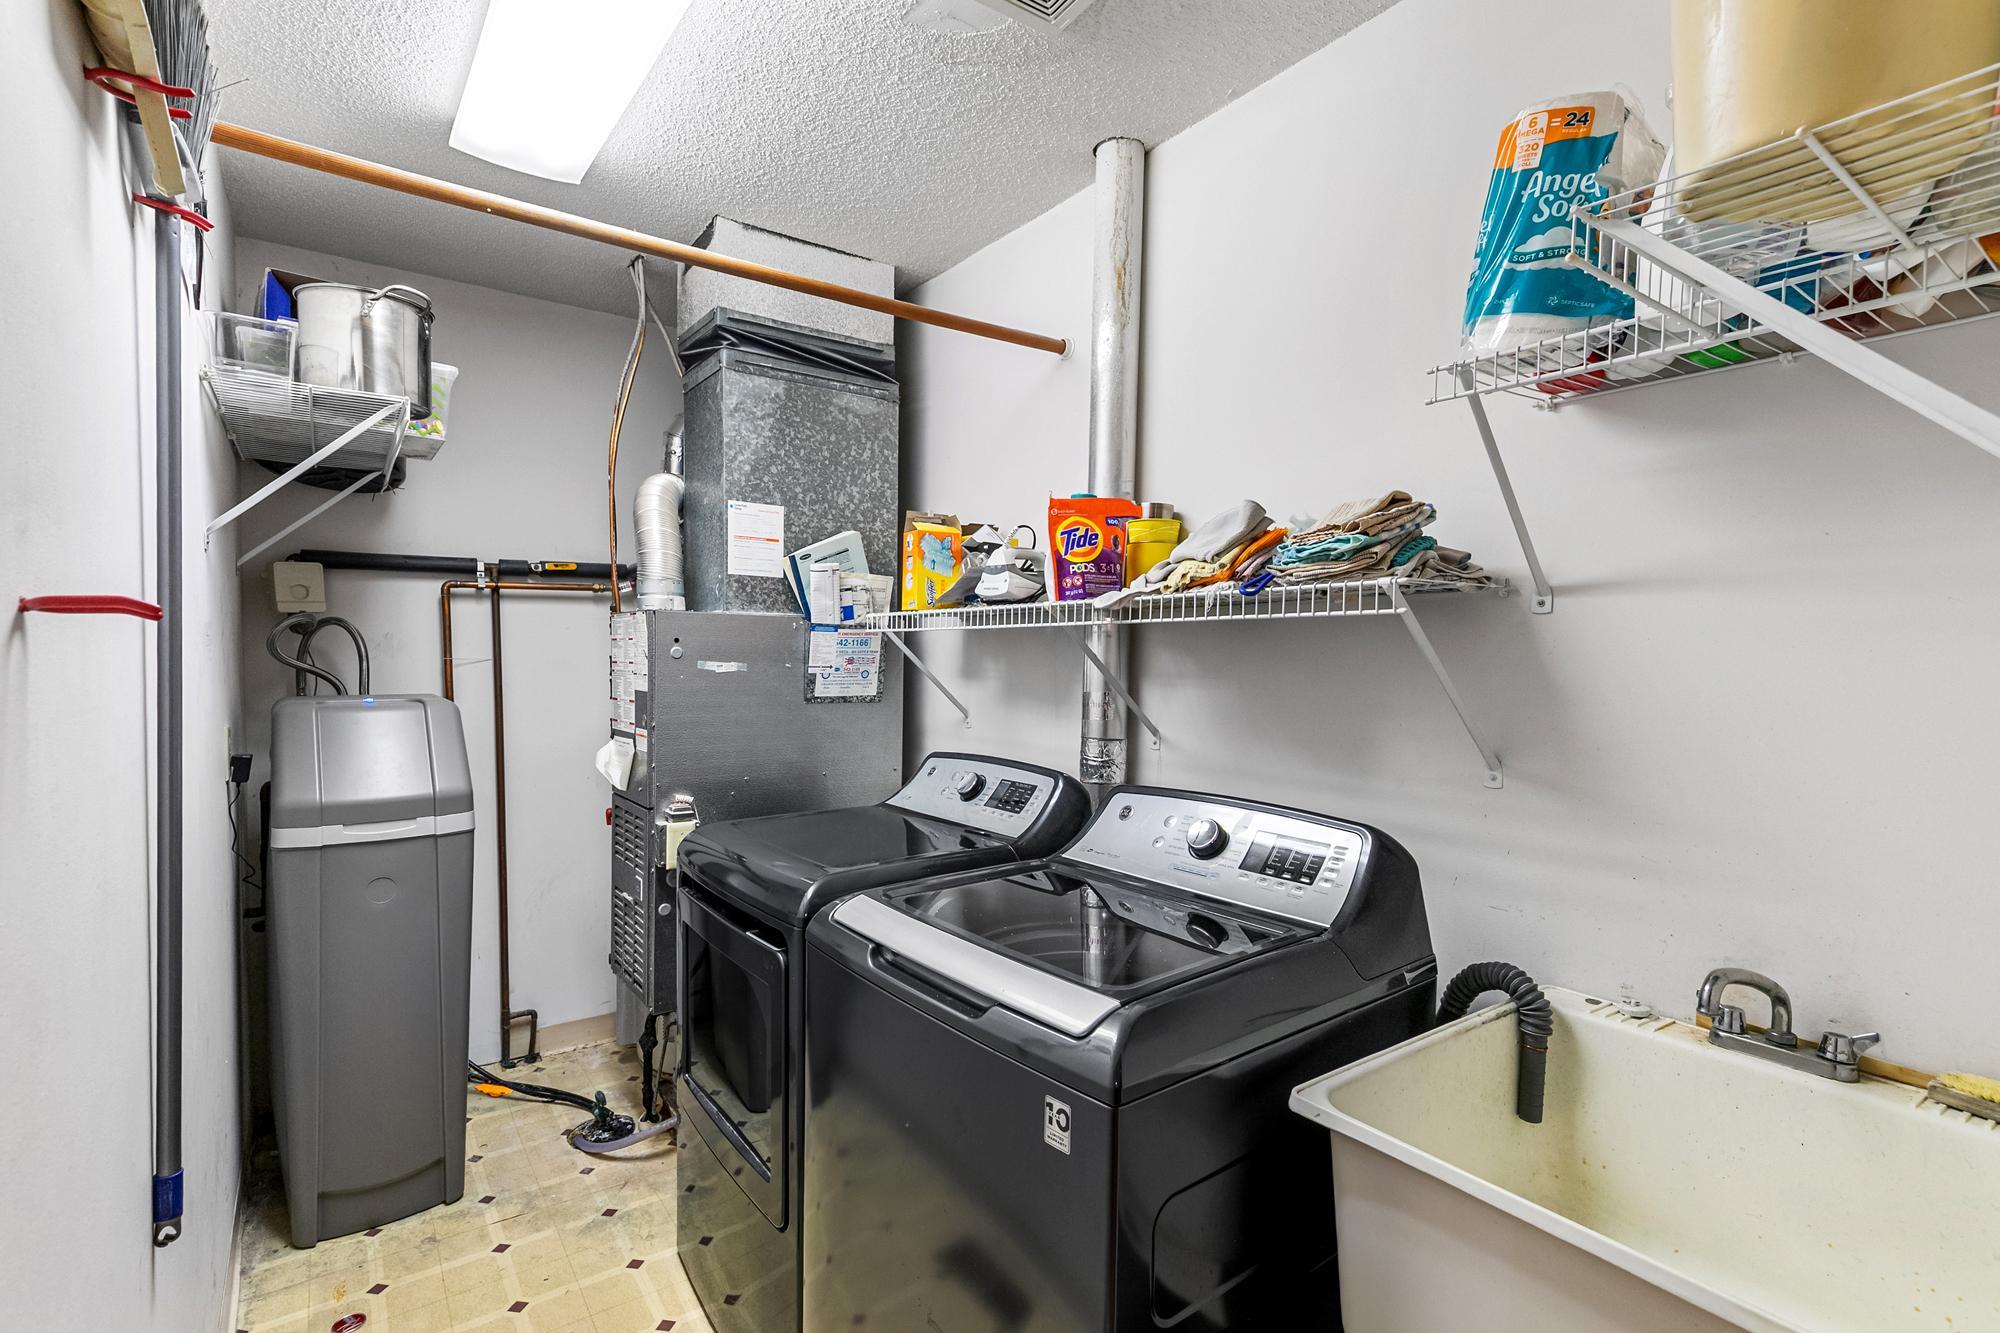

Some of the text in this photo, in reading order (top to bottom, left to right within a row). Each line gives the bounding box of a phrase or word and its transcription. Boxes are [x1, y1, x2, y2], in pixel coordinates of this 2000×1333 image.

[1528, 116, 1539, 129] 6
[1563, 111, 1590, 127] 24
[1518, 128, 1545, 137] MEGA
[1513, 253, 1536, 262] SOFT
[1060, 525, 1100, 558] Tide
[1069, 562, 1096, 575] PODS
